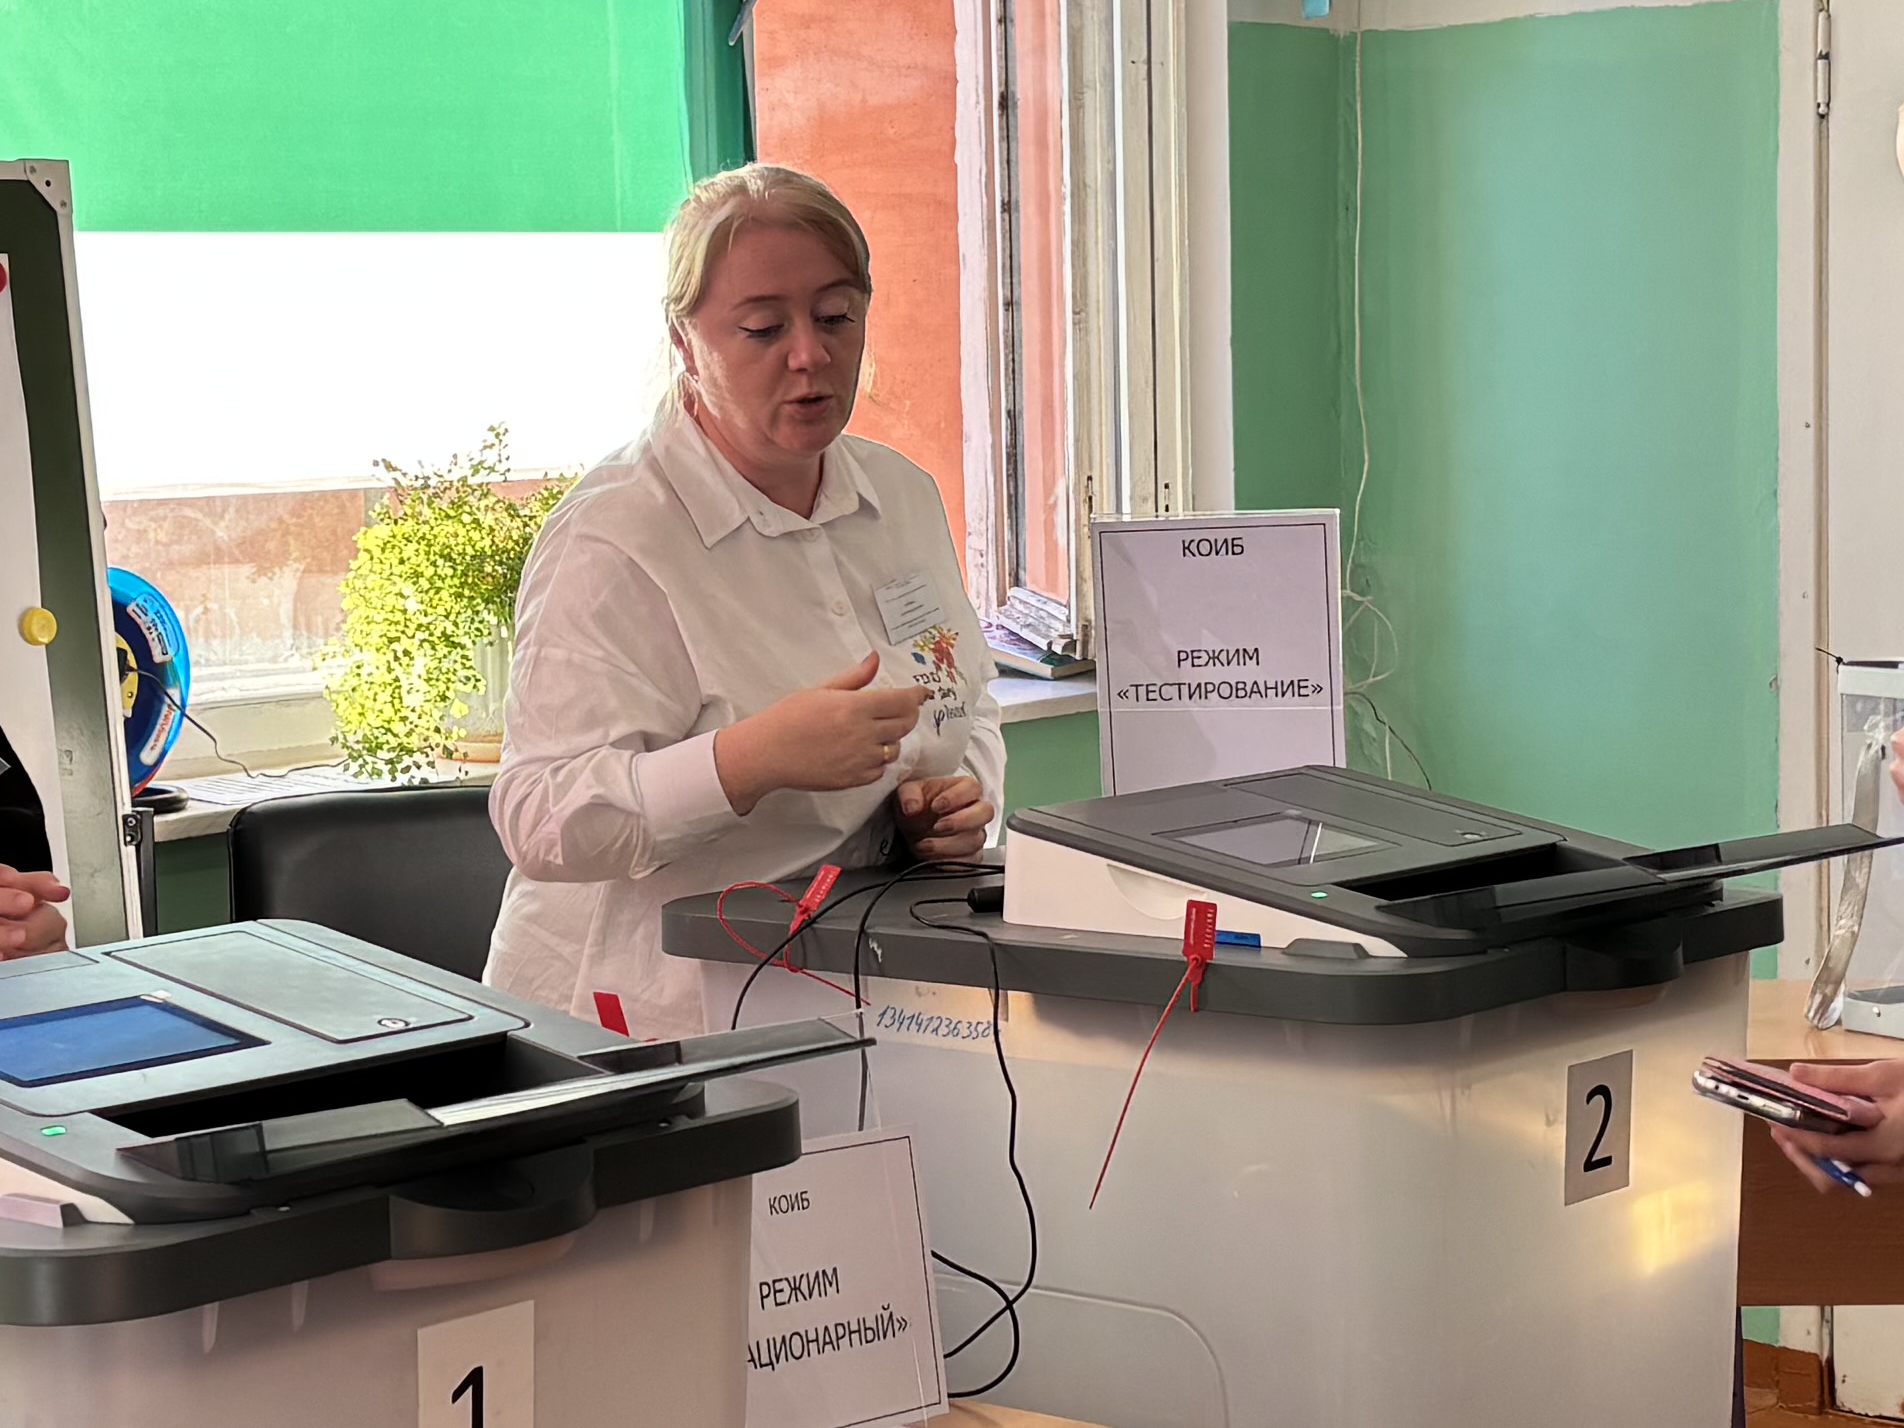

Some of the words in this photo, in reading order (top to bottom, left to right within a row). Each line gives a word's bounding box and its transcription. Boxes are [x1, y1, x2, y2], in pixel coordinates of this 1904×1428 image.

[1181, 537, 1245, 558] КОИБ
[1176, 647, 1261, 669] РЕЖИМ
[1116, 678, 1324, 703] «ТЕСТИРОВАНИЕ»
[876, 1004, 1000, 1042] 134141236358
[1583, 1084, 1613, 1173] 2
[767, 1190, 811, 1216] КОИБ
[758, 1267, 840, 1311] РЕЖИМ
